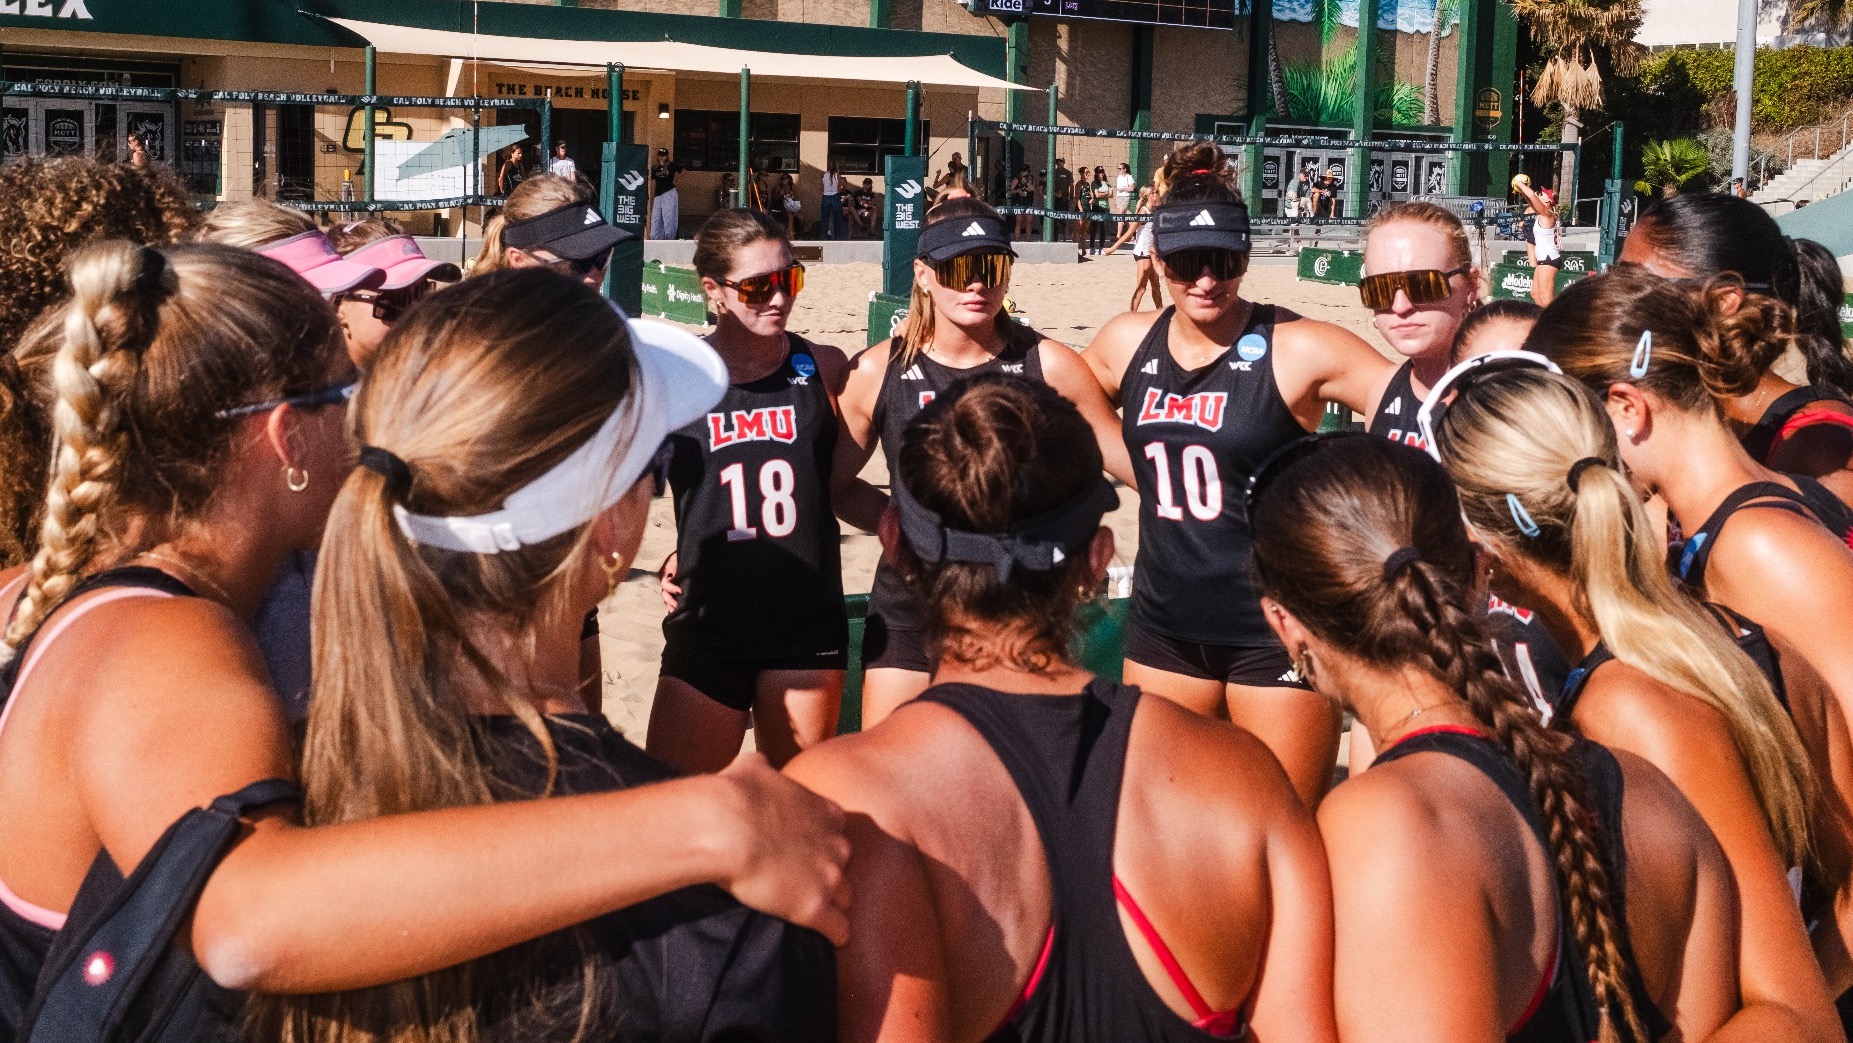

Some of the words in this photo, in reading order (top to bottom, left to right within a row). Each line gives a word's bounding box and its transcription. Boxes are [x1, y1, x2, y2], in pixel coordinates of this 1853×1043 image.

[14, 83, 33, 92] CAL
[35, 84, 60, 93] POLY
[63, 86, 96, 95] BEACH
[99, 86, 161, 97] VOLLEYBALL
[496, 83, 527, 96] THE
[590, 88, 640, 101] HOSE
[212, 91, 231, 99] CAL
[232, 92, 255, 100] POLY
[257, 93, 287, 101] BEACH
[290, 93, 346, 103] VOLLEYBALL
[411, 97, 433, 105] POLY
[434, 98, 461, 106] BEACH
[416, 202, 437, 210] POLY
[618, 195, 636, 206] THE
[618, 204, 634, 214] BIG
[896, 203, 914, 213] THE
[616, 214, 641, 224] WEST
[896, 211, 912, 221] BIG
[895, 220, 920, 229] WEST
[1502, 272, 1533, 288] Modelo
[676, 289, 691, 303] Dignity
[1137, 387, 1228, 433] LMU
[707, 405, 797, 453] LMU
[1144, 441, 1223, 521] 10
[720, 459, 797, 541] 18
